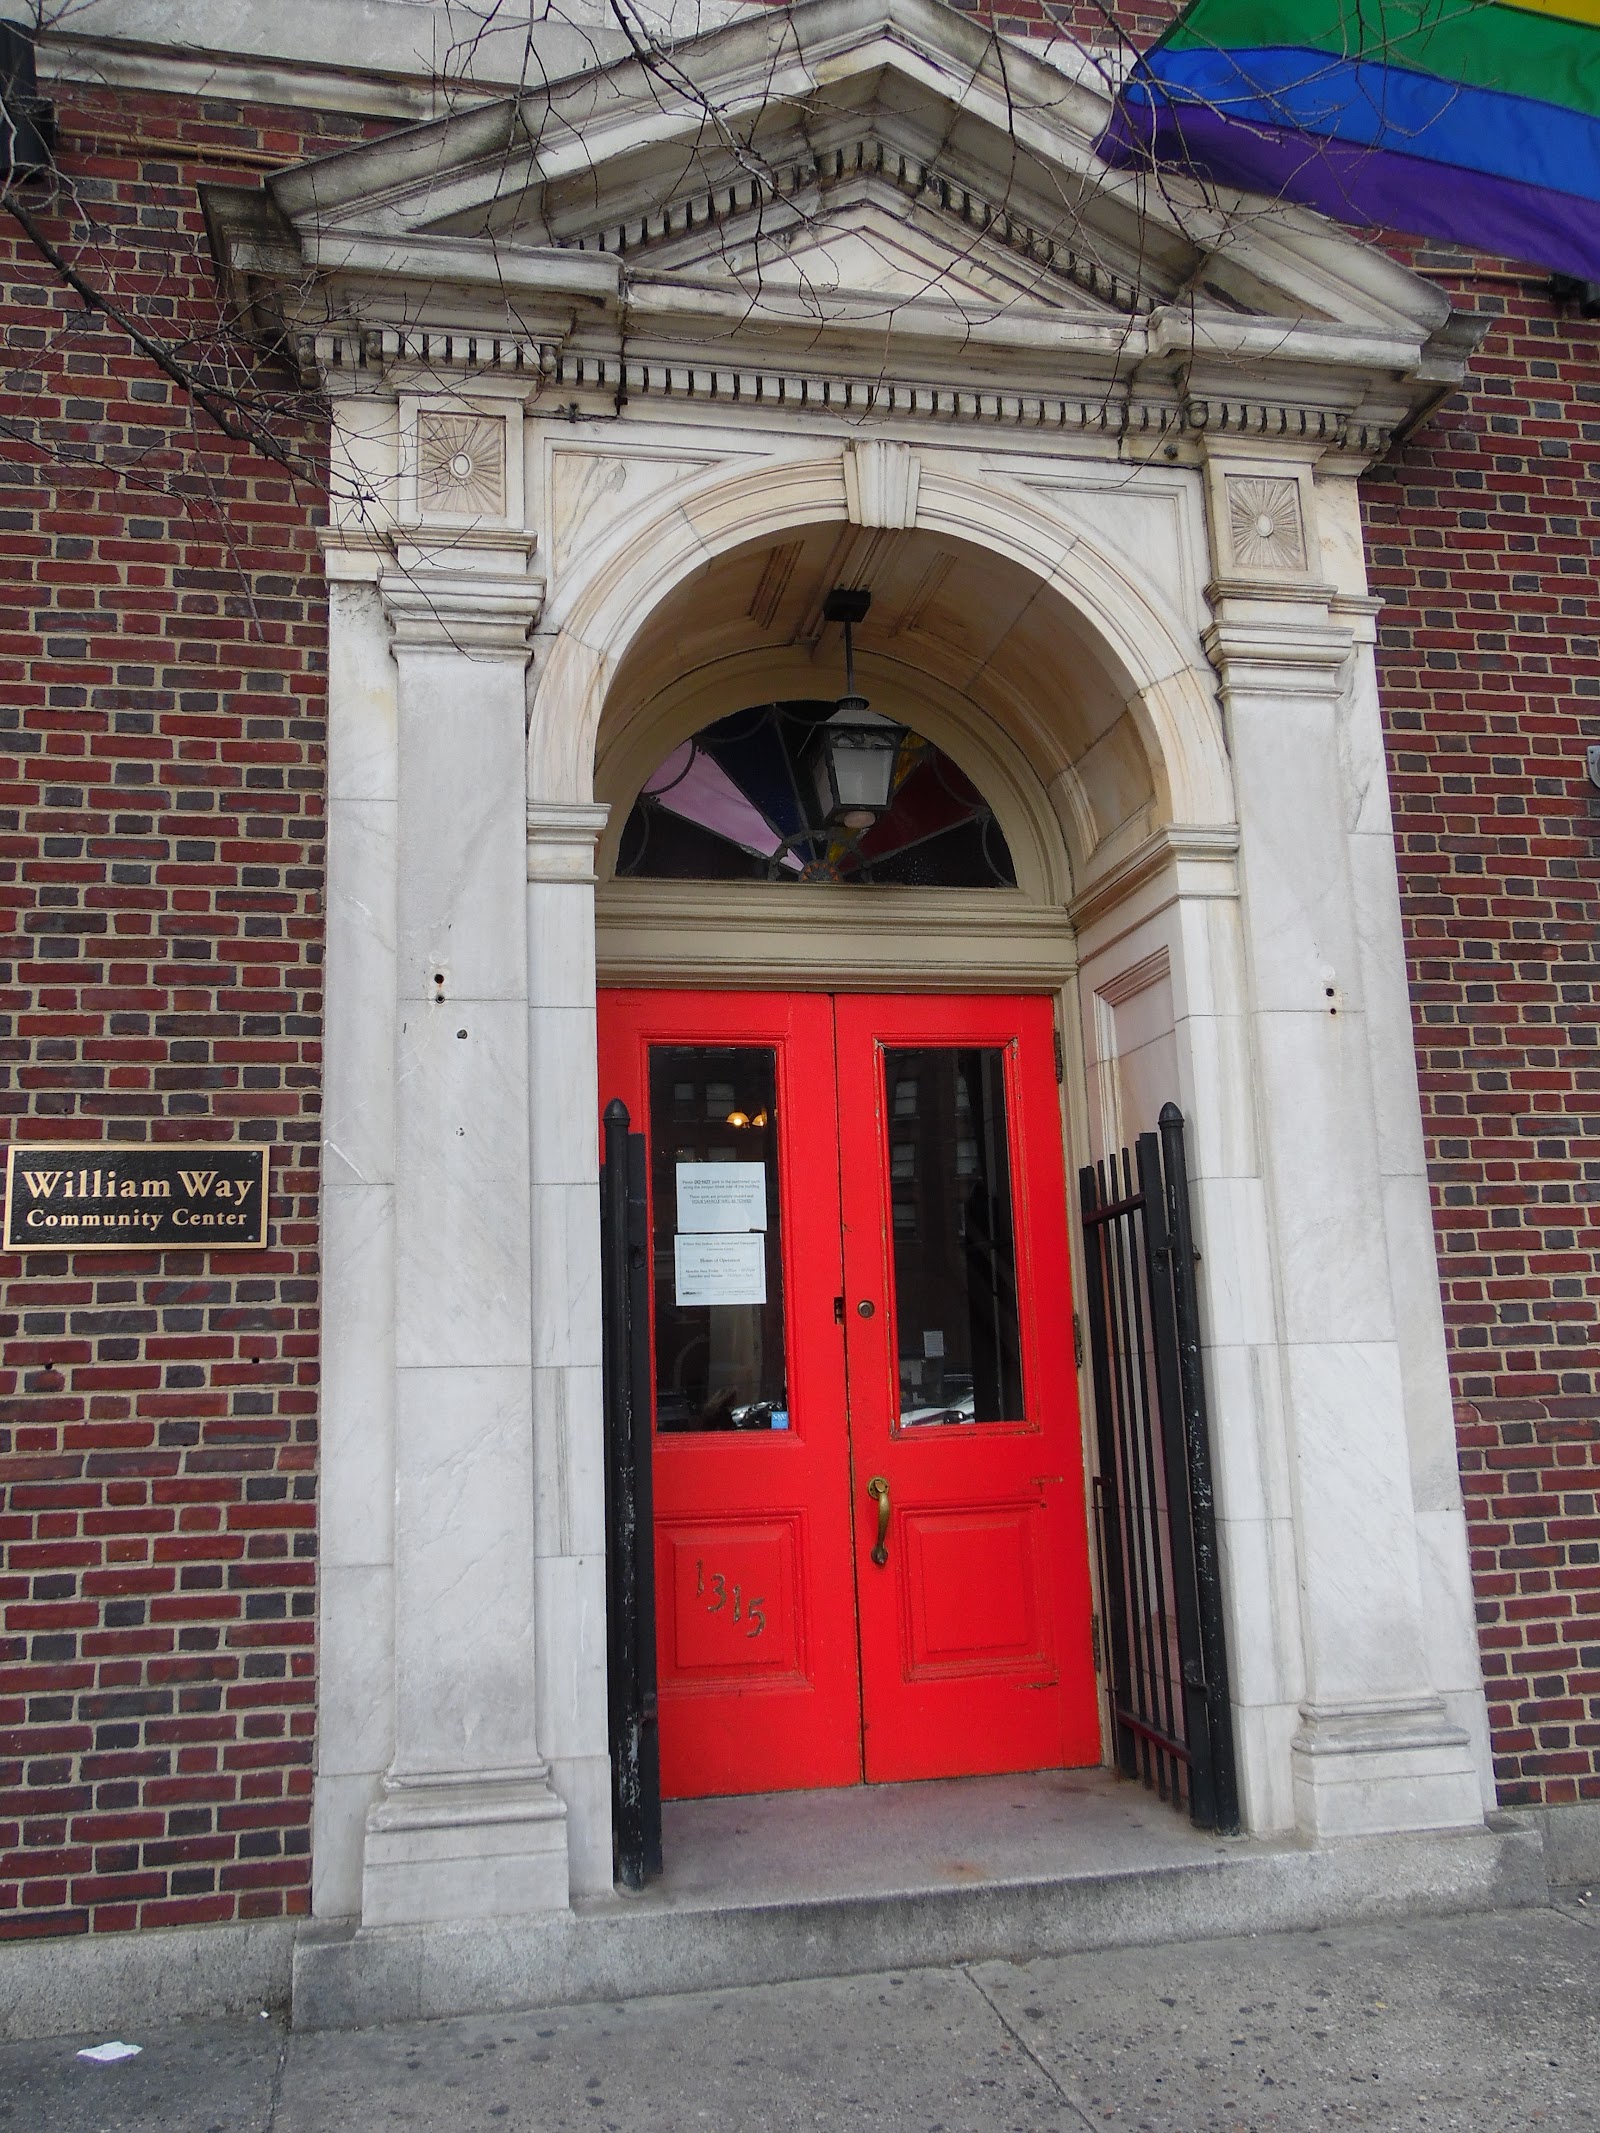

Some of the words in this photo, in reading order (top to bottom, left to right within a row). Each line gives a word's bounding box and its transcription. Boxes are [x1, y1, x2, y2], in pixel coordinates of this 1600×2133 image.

[22, 1170, 171, 1198] William
[177, 1171, 255, 1205] Way
[26, 1208, 163, 1231] Community
[171, 1208, 247, 1226] Center
[694, 1558, 766, 1638] 1315
